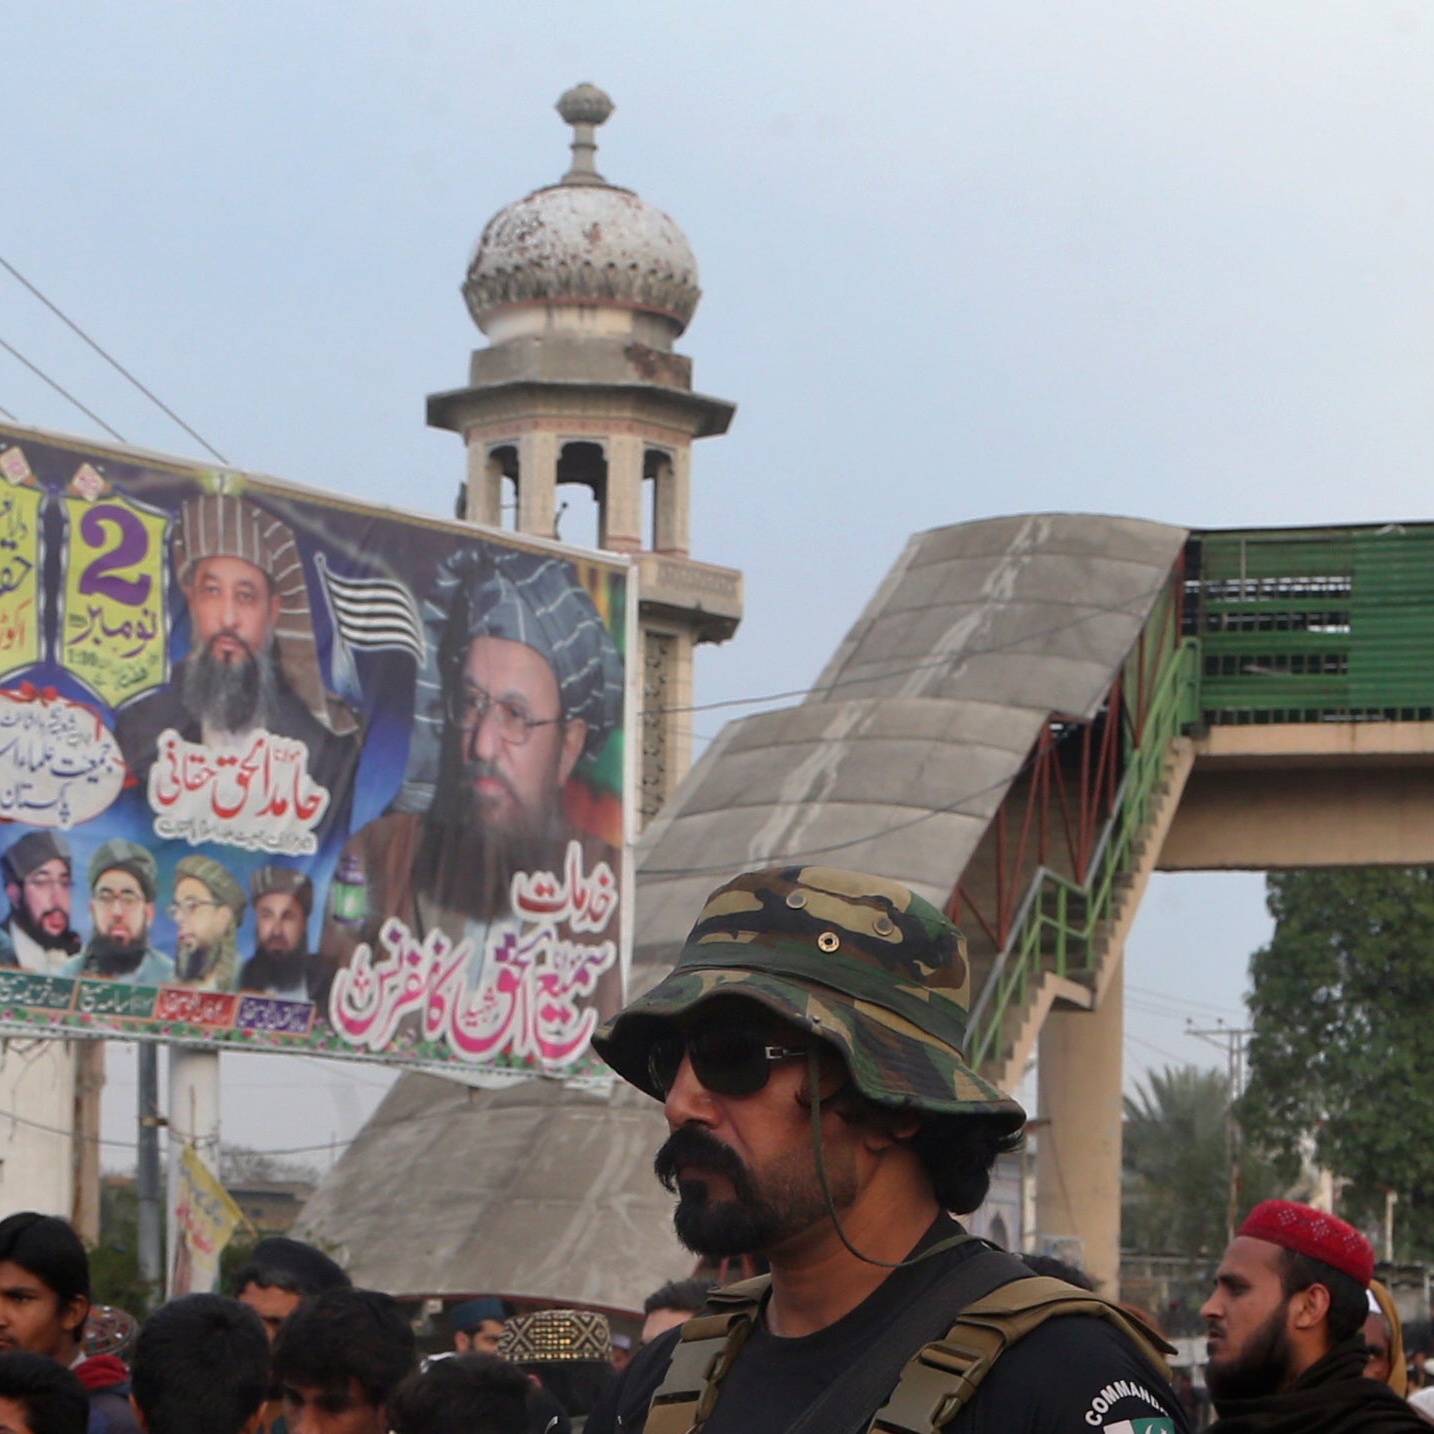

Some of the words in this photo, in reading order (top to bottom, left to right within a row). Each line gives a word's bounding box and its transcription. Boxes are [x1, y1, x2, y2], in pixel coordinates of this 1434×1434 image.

[78, 504, 152, 607] 2
[65, 604, 157, 659] نومبر
[156, 739, 217, 807] حقانی
[255, 762, 323, 821] حامد
[517, 856, 612, 923] خدمات
[337, 927, 471, 1043] کانفرنس
[533, 942, 608, 1059] سمیع
